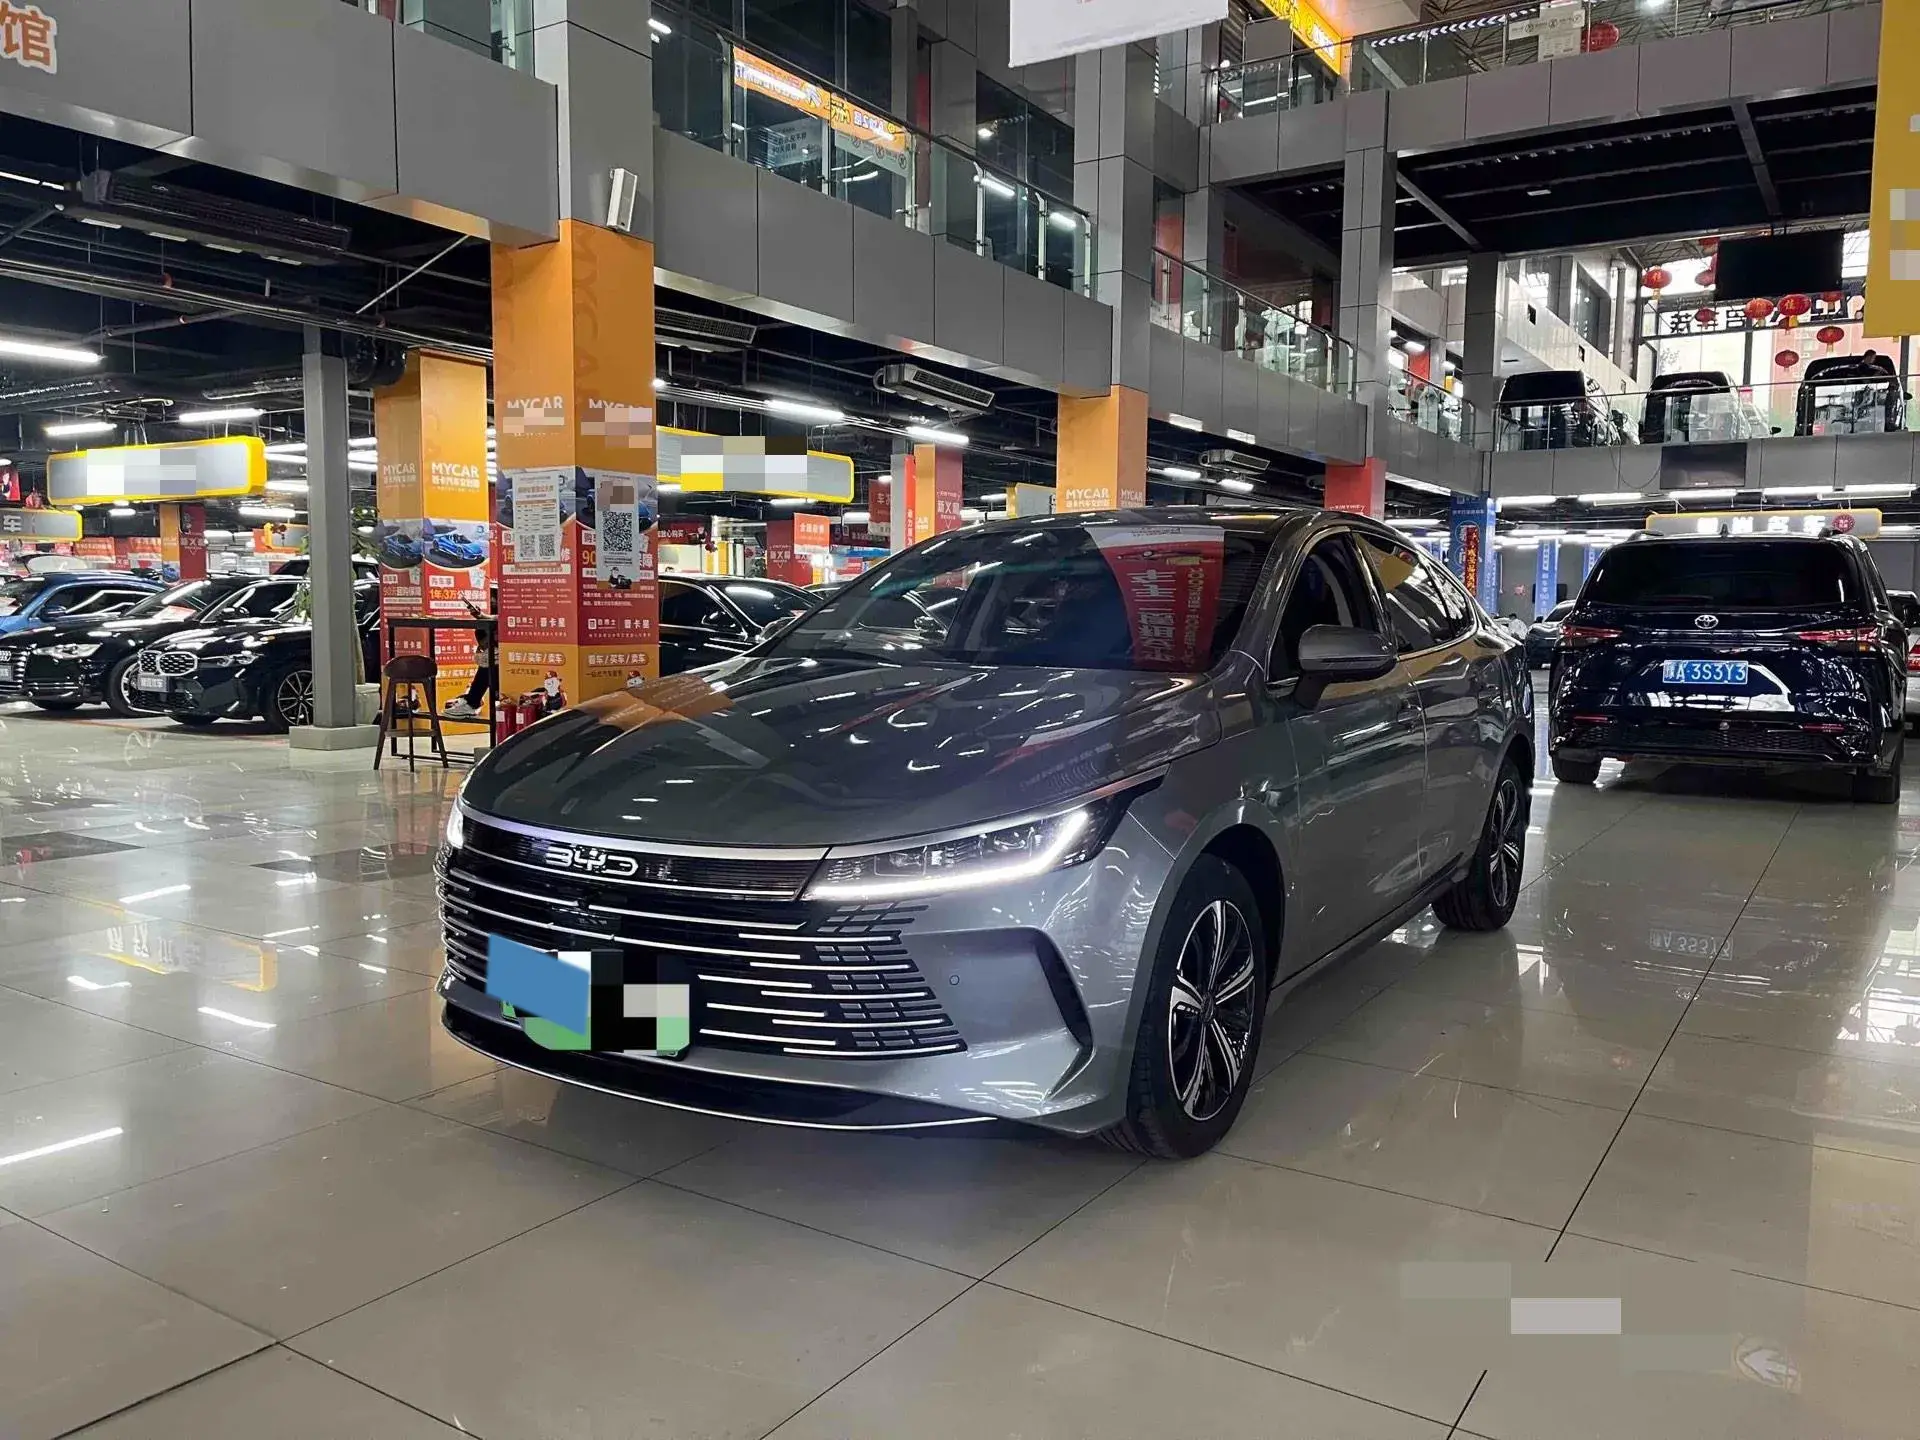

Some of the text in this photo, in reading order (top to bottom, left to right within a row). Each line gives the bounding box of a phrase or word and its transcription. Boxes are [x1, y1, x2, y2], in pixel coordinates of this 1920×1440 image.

[383, 463, 416, 475] MYCAR
[431, 462, 479, 478] MYCAR
[1065, 488, 1109, 500] MYCAR
[1120, 489, 1143, 503] MYCAR
[545, 846, 639, 876] BYD
